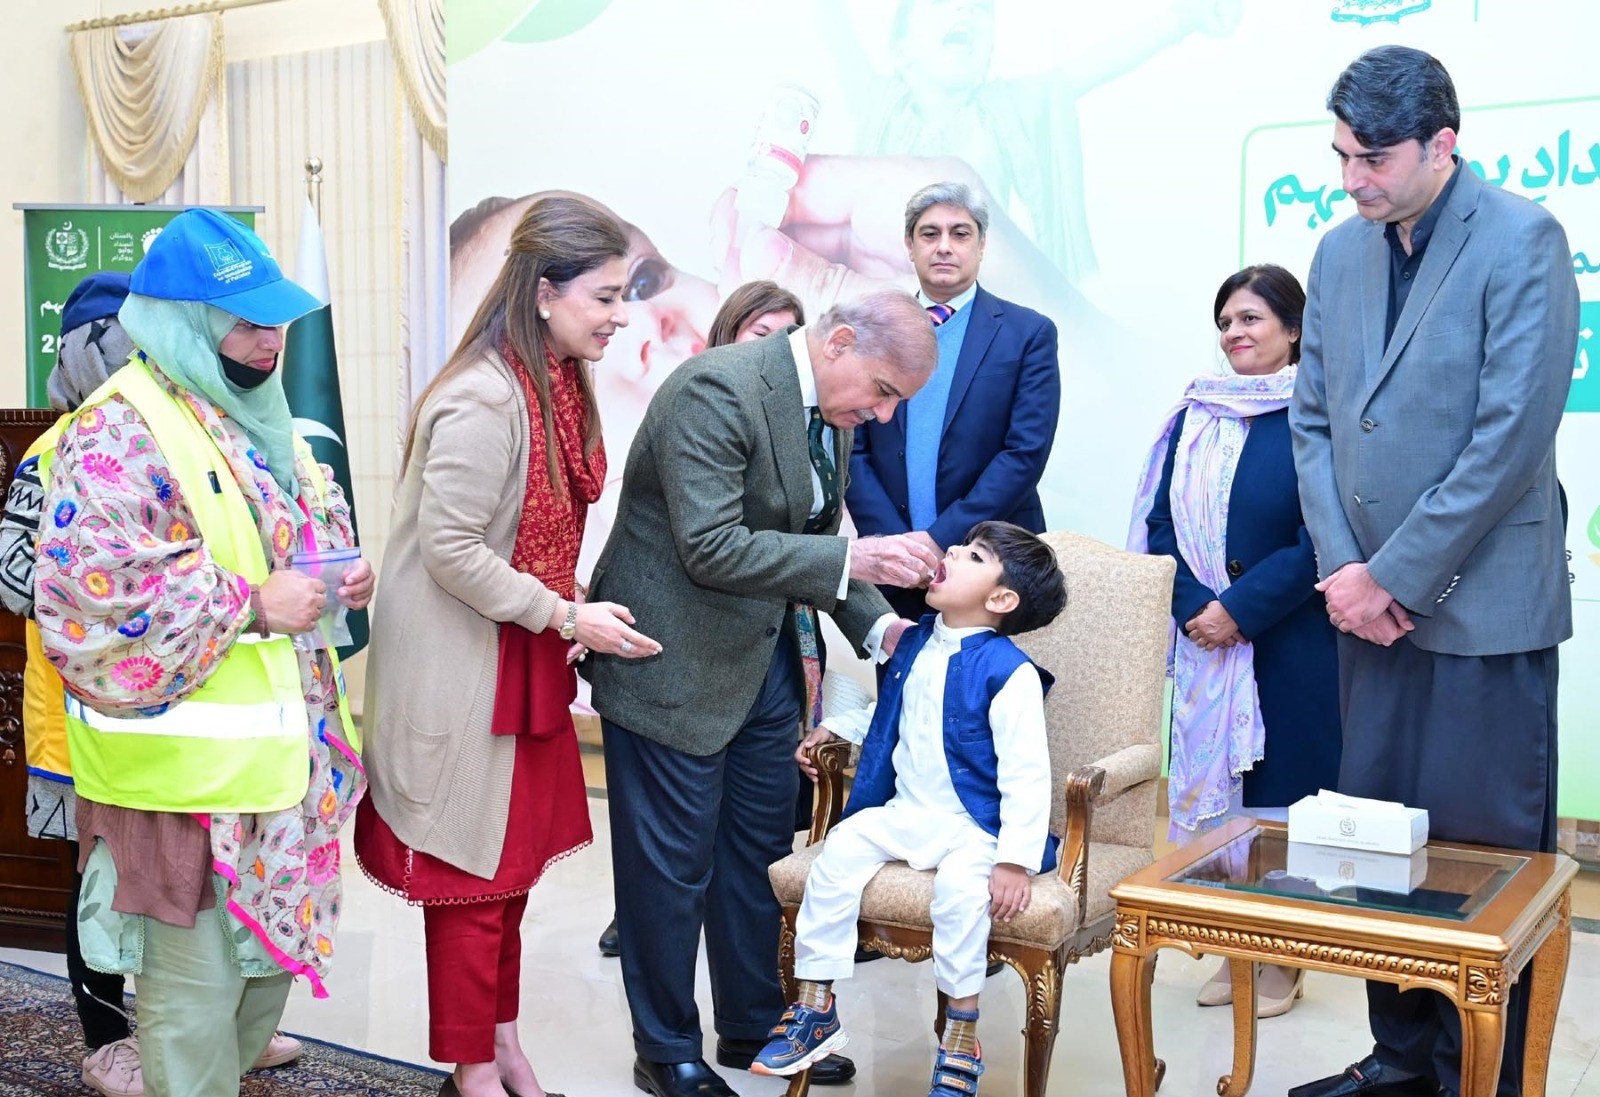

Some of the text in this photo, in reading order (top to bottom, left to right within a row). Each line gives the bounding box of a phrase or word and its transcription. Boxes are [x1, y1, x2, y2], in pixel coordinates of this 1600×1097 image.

[109, 232, 133, 240] پاکستان
[117, 247, 133, 255] پولیو
[111, 254, 134, 262] پروگرام
